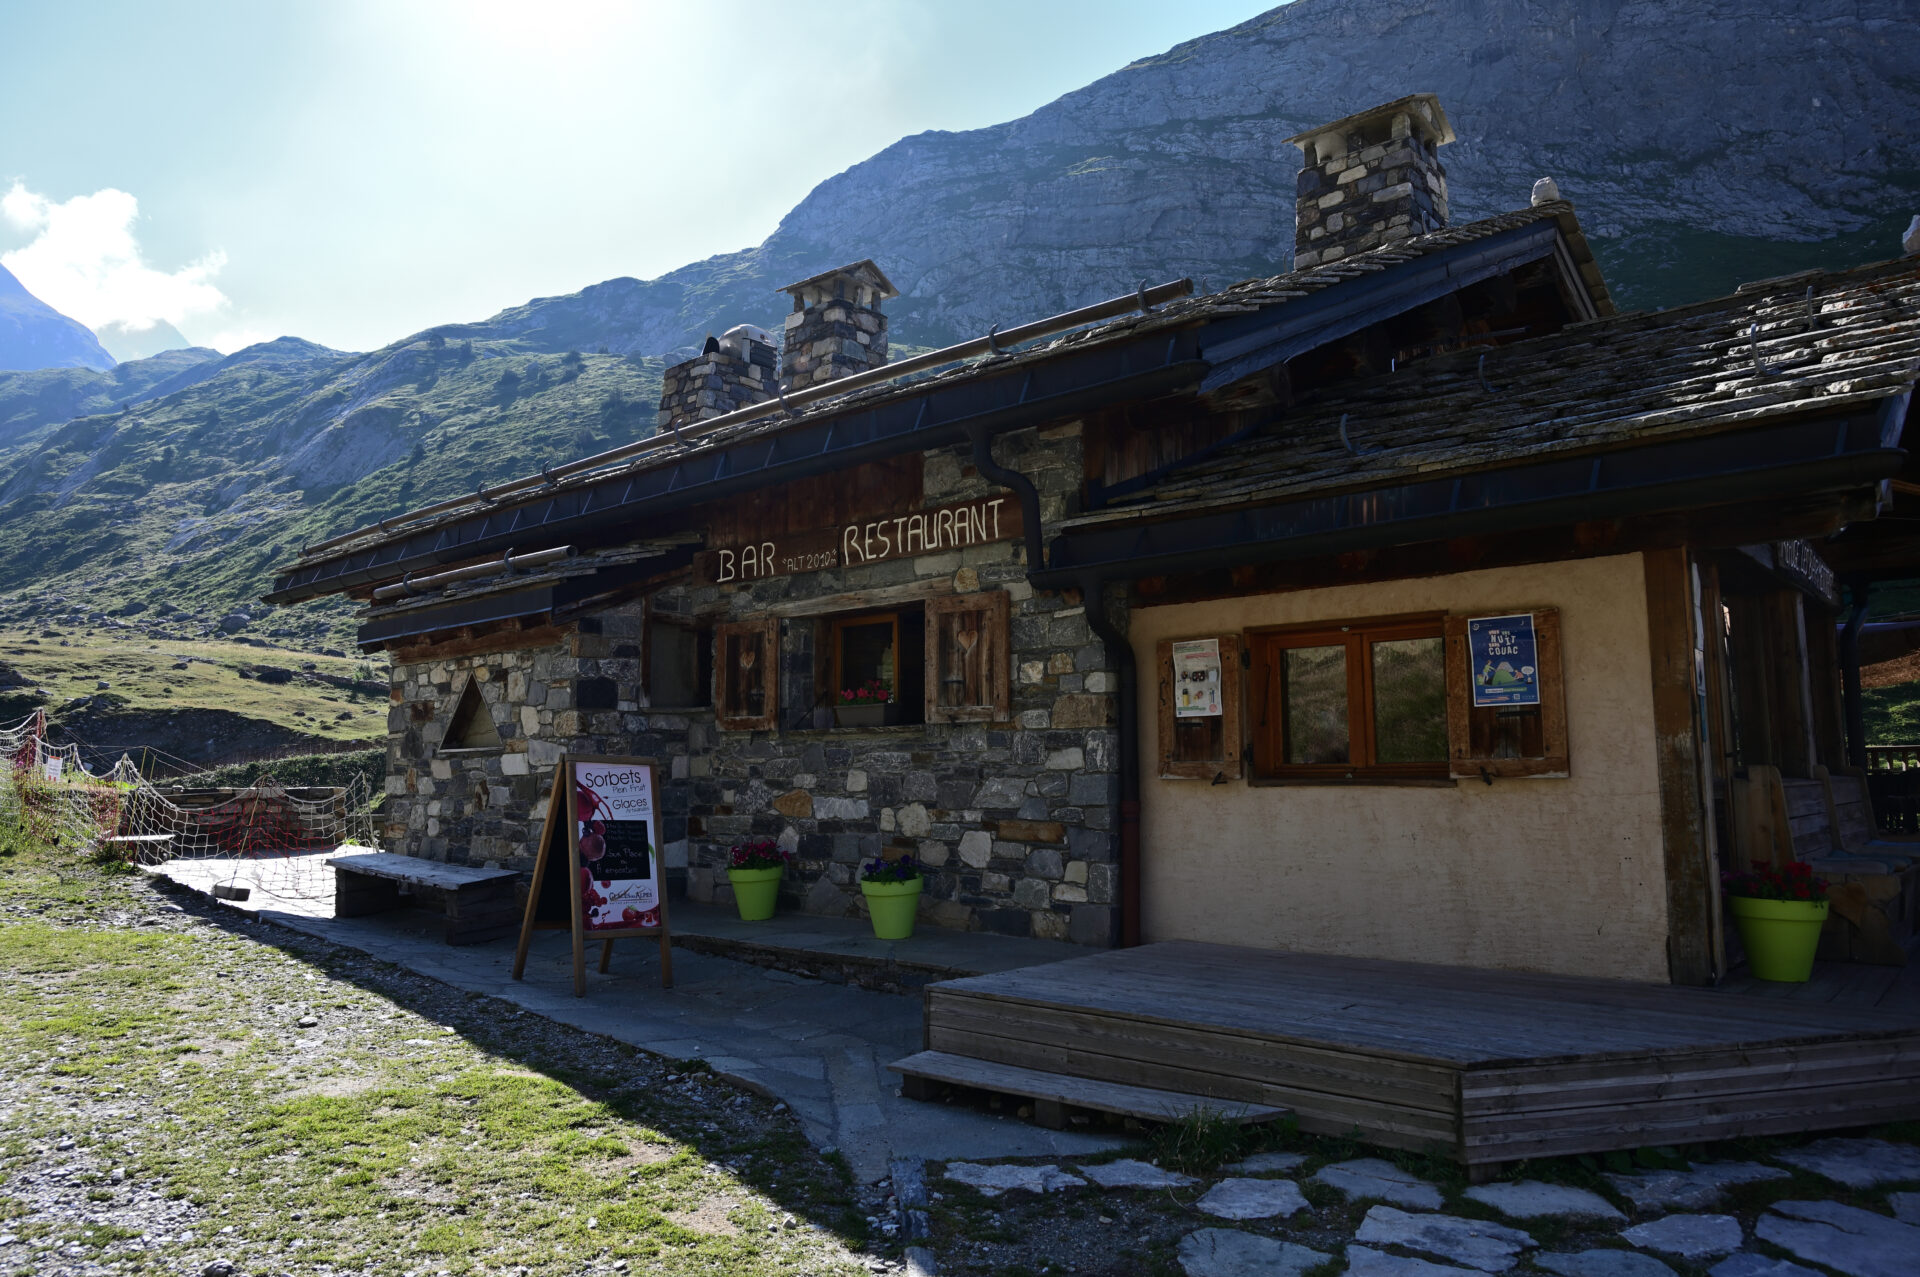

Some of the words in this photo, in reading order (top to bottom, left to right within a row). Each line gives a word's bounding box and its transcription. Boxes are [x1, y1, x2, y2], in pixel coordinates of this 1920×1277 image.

[717, 542, 776, 583] BAR
[843, 499, 1004, 566] RESTAURANT
[1491, 635, 1517, 646] NUIT
[1489, 647, 1519, 656] COUAC
[585, 769, 641, 789] Sorbets
[629, 784, 646, 793] Fruit
[612, 798, 648, 810] Glaces
